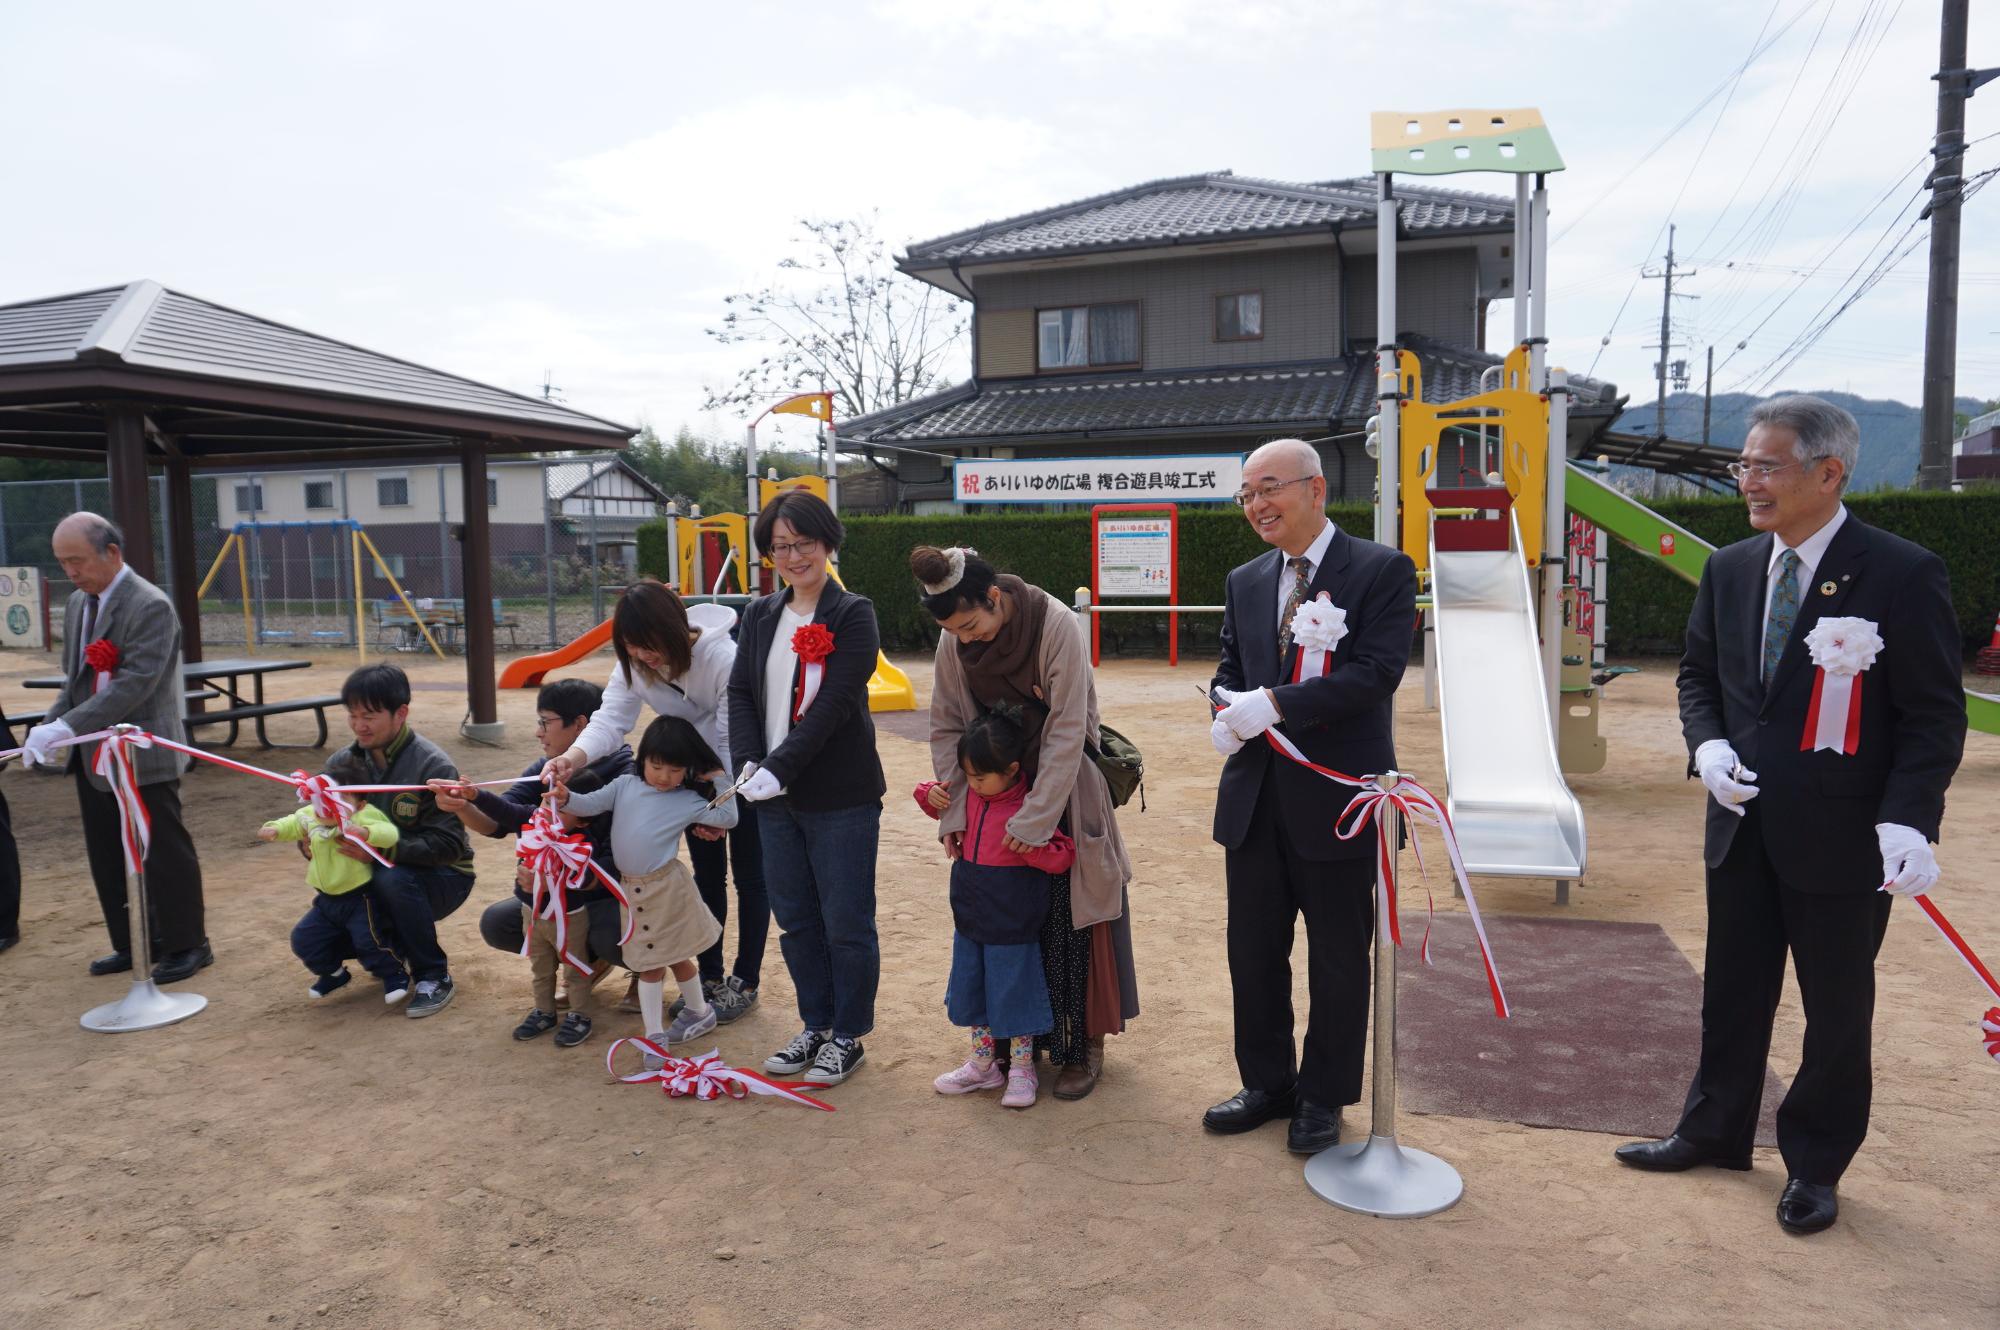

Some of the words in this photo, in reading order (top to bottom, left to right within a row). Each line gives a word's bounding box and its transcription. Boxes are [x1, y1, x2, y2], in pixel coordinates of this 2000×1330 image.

[962, 474, 980, 494] 祝
[984, 473, 1092, 491] ありいゆめ広場
[1097, 471, 1216, 491] 複合遊具竣工式
